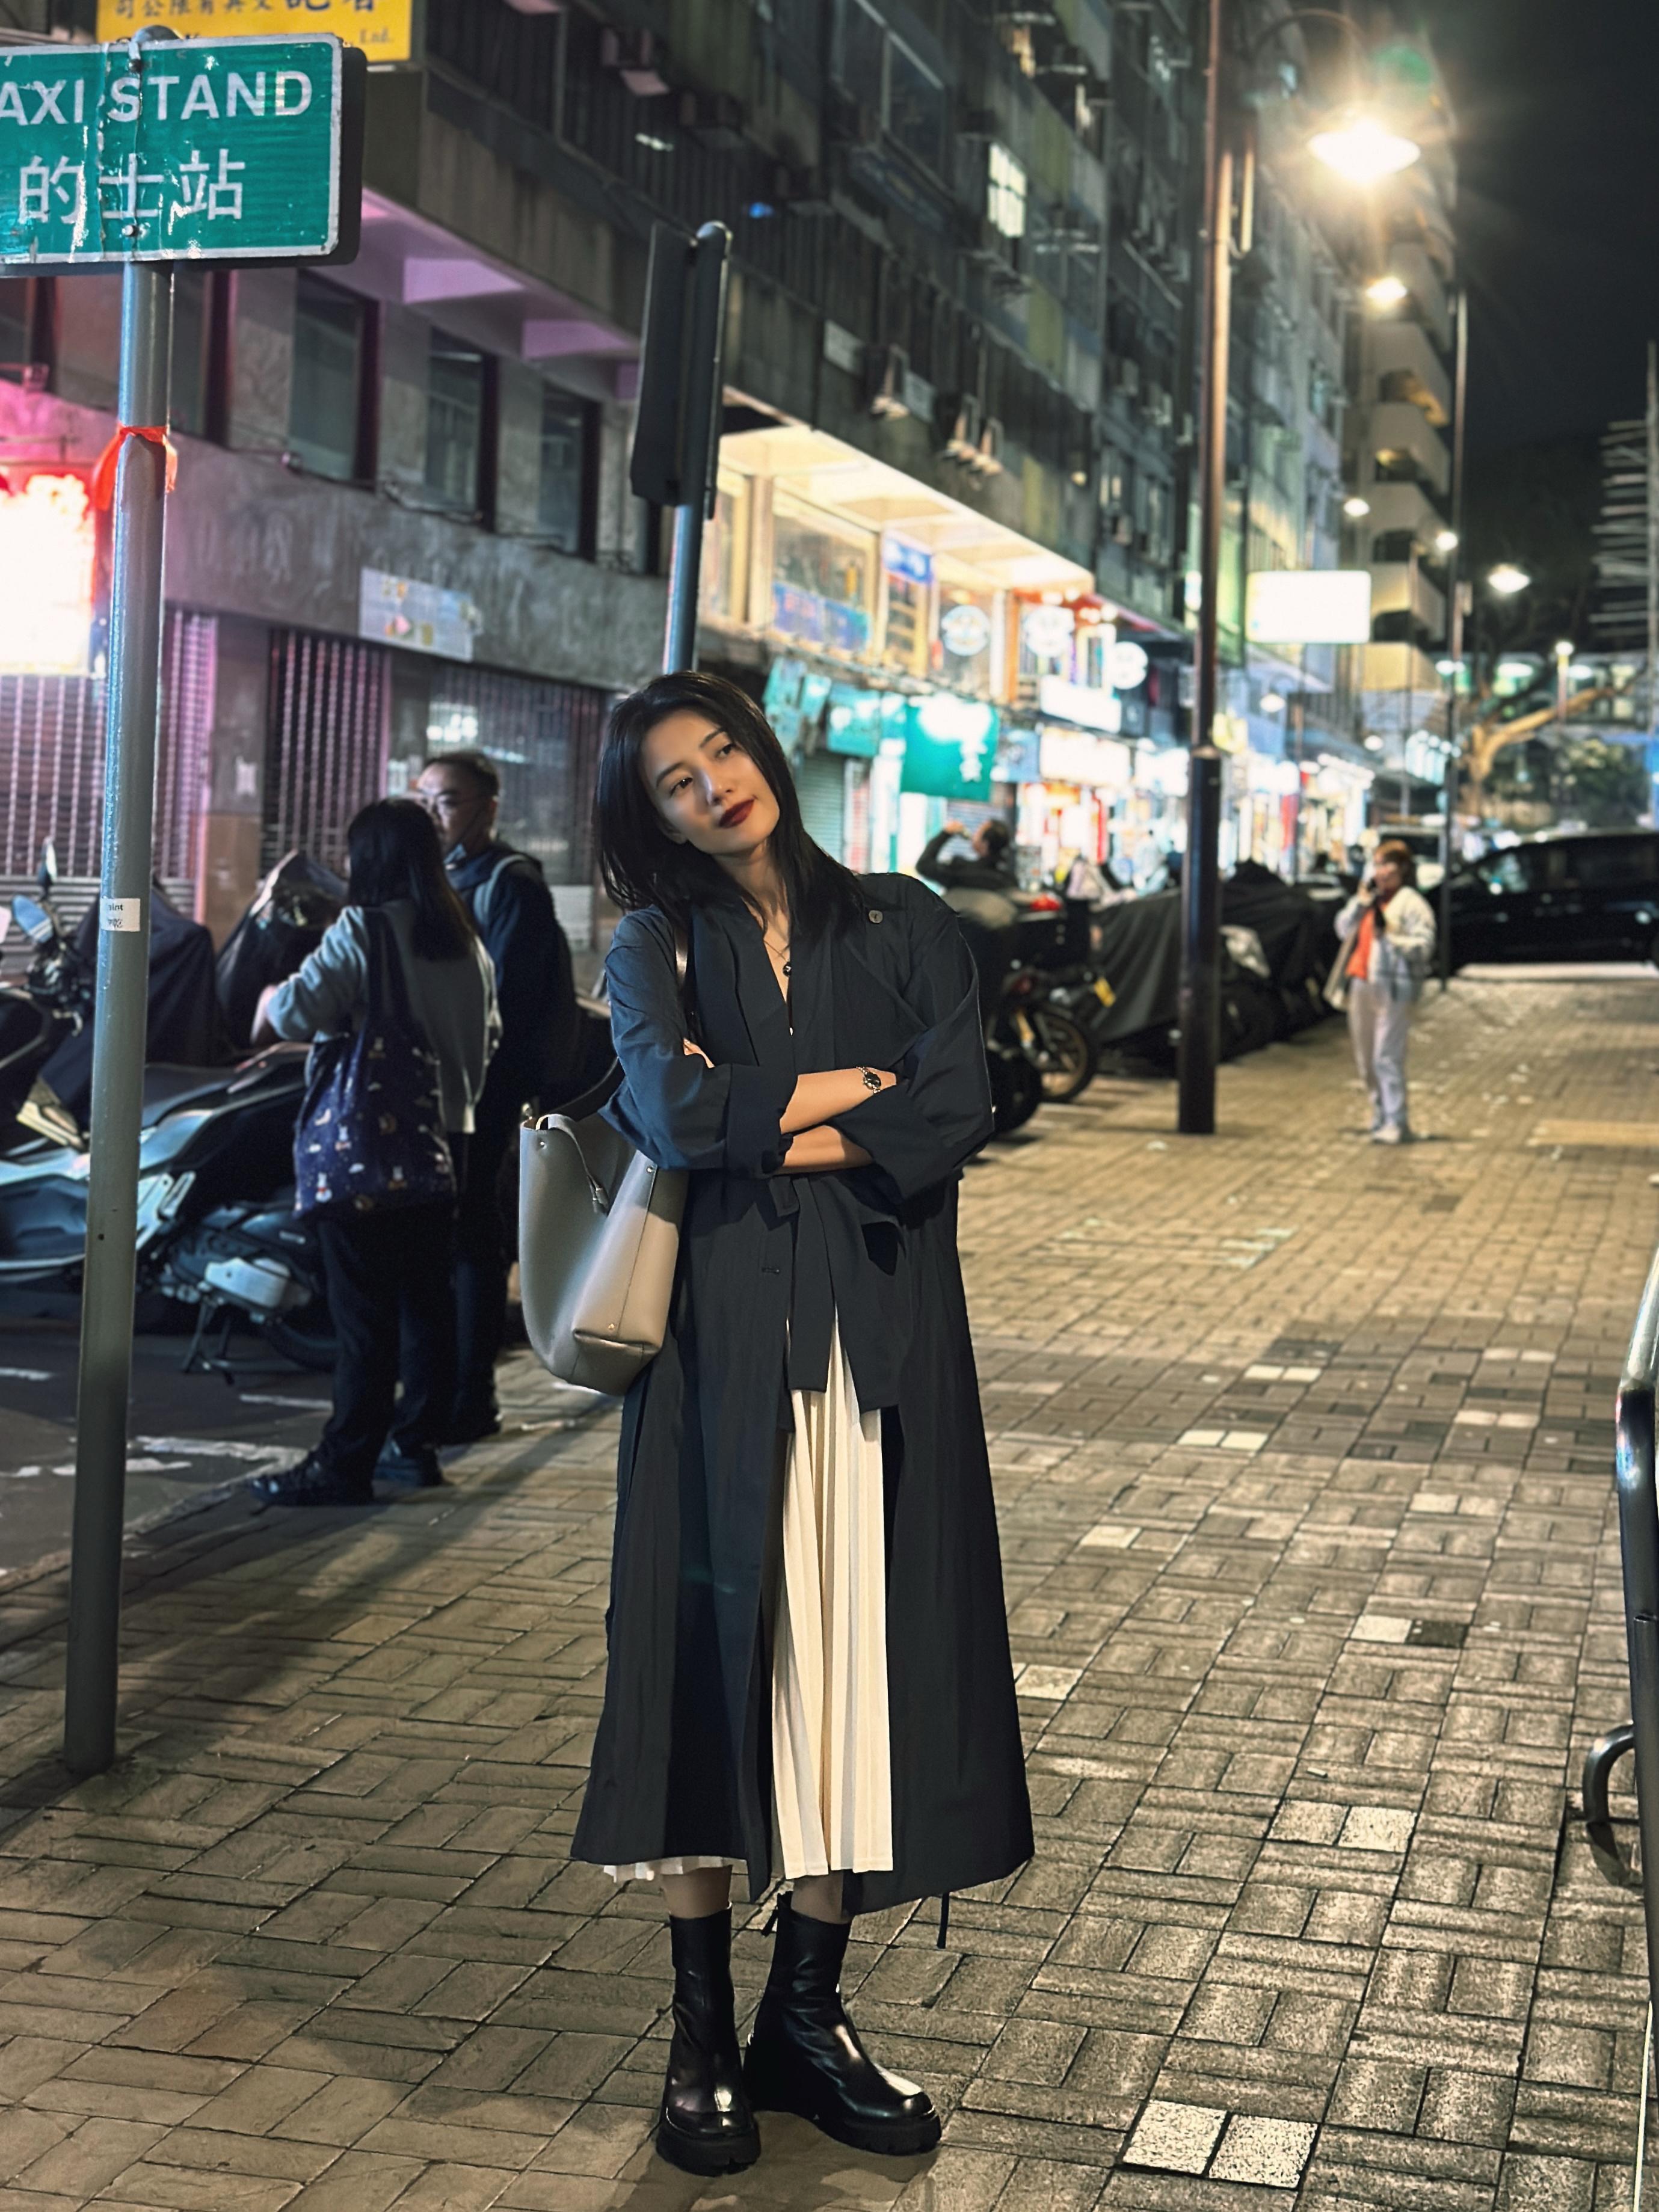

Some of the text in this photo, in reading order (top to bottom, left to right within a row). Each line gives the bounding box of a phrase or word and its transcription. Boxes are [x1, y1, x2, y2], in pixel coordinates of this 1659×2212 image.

[0, 70, 313, 126] AXI STAND
[18, 148, 246, 224] 的士站
